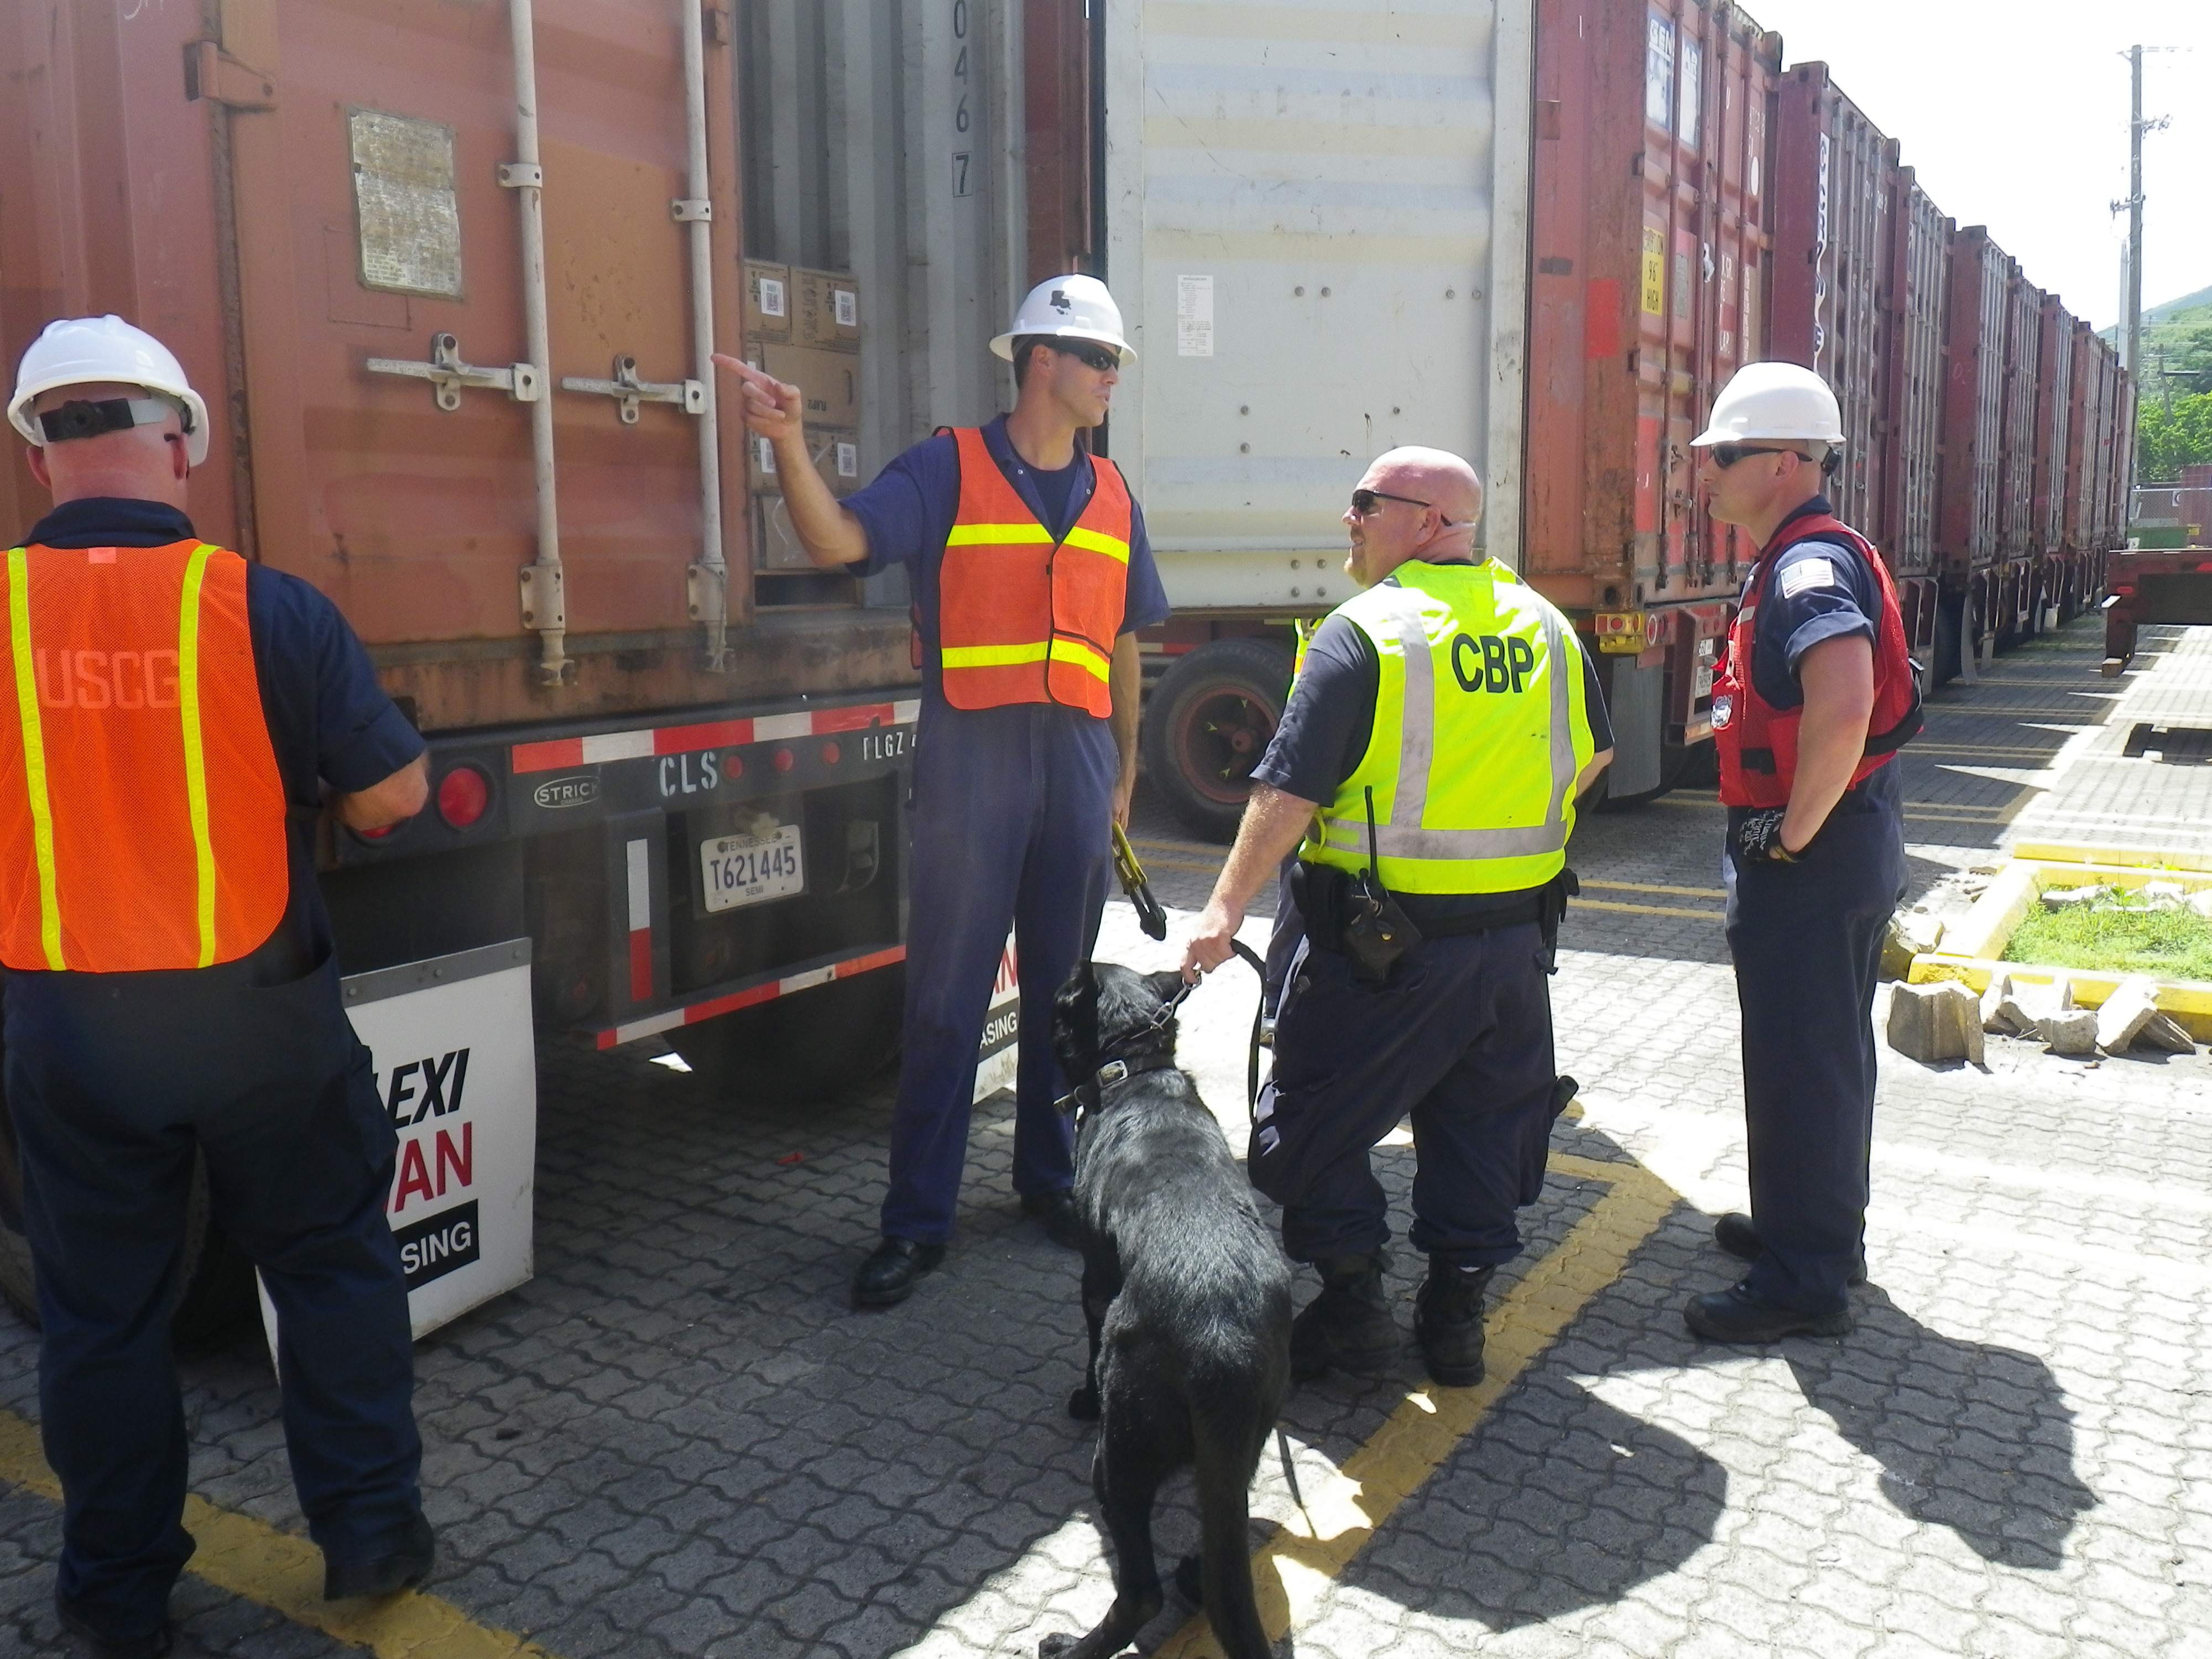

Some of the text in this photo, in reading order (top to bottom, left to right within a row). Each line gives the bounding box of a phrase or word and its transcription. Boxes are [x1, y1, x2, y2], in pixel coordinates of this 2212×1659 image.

[1647, 288, 1659, 311] HIGH
[37, 648, 180, 709] USCG
[1452, 633, 1534, 693] CBP
[658, 752, 718, 797] CLS
[710, 845, 796, 891] T621445
[745, 885, 764, 896] SEMI
[373, 1047, 471, 1130] EXI
[384, 1121, 472, 1213] AN
